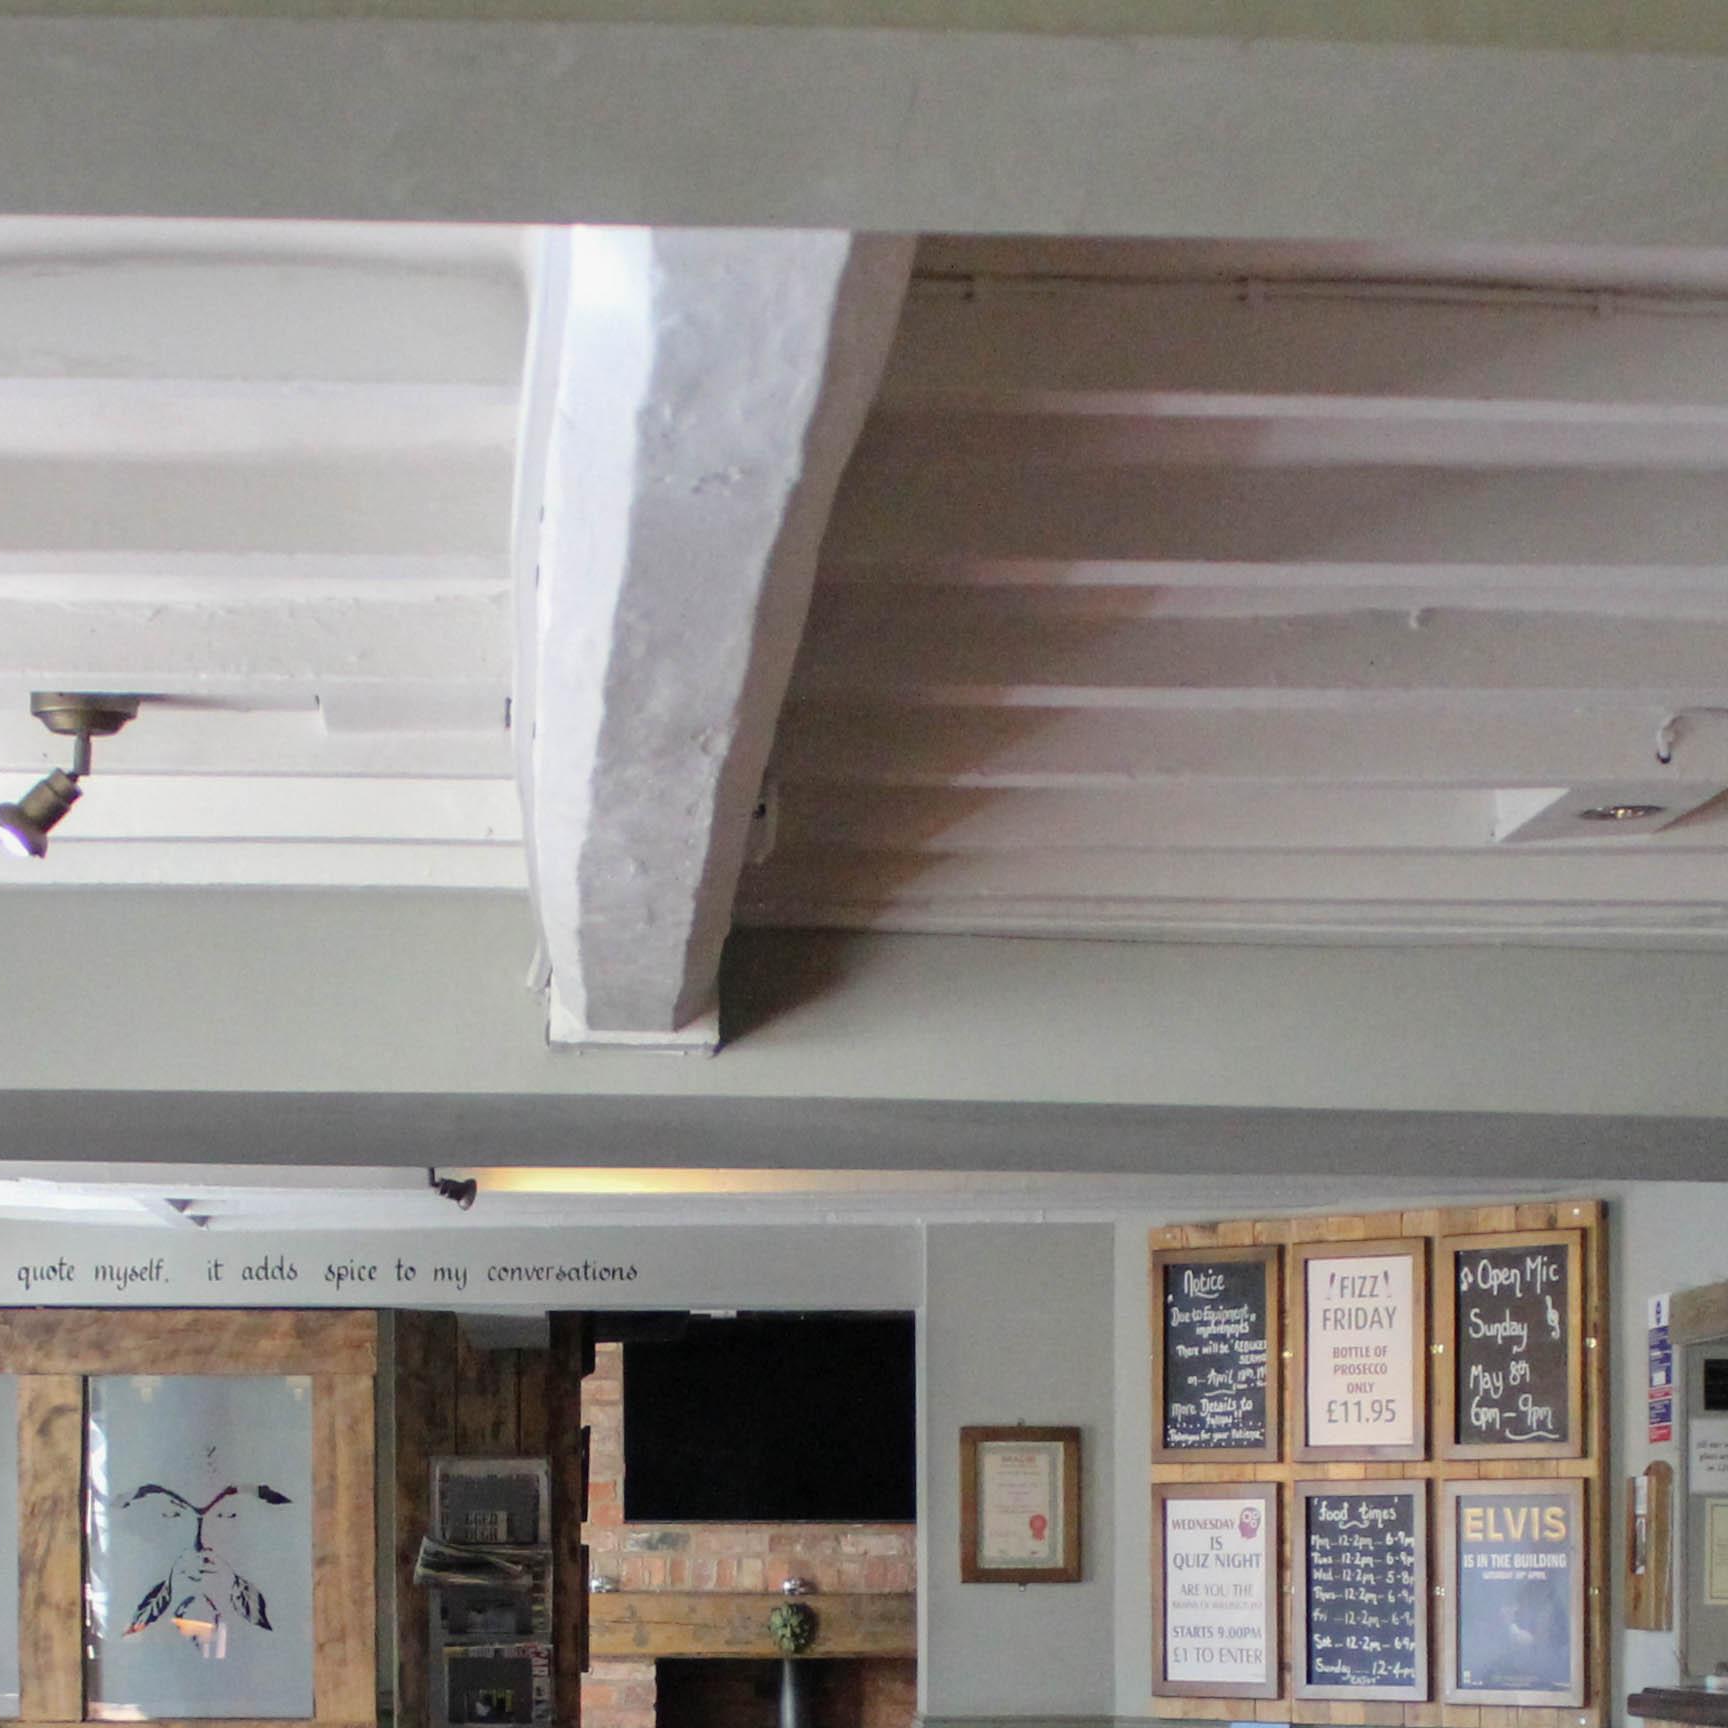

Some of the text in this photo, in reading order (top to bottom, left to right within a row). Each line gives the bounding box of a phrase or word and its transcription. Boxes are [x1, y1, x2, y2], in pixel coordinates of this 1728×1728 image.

[17, 1257, 74, 1290] quote
[94, 1257, 170, 1291] myself.
[207, 1258, 225, 1282] it
[241, 1256, 298, 1282] adds
[324, 1258, 377, 1291] spice
[395, 1258, 417, 1282] to
[433, 1264, 468, 1291] my
[487, 1258, 638, 1282] conversations
[1184, 1268, 1225, 1297] Notice
[1477, 1255, 1560, 1298] Open Mic
[1322, 1306, 1397, 1331] FRIDAY
[1469, 1307, 1528, 1353] Sunday
[1332, 1345, 1388, 1359] BOTTLE OF
[1333, 1362, 1388, 1375] PROSECCO
[1346, 1382, 1375, 1394] ONLY
[1470, 1359, 1530, 1399] May 8th
[1240, 1397, 1253, 1411] to
[1326, 1399, 1397, 1424] £11.95
[1471, 1396, 1501, 1431] 6pm
[1519, 1394, 1553, 1430] 9pm
[1171, 1518, 1236, 1531] WEDNESDAY
[1463, 1506, 1568, 1542] ELVIS
[1210, 1536, 1223, 1551] IS
[1173, 1552, 1262, 1571] QUIZ NIGHT
[1464, 1553, 1567, 1568] IS IN THE BUILDING
[1180, 1583, 1254, 1598] ARE YOU THE
[1173, 1625, 1262, 1639] STARTS 9.00PM
[1173, 1647, 1263, 1665] £1 TO ENTER
[1315, 1657, 1352, 1680] Sunday
